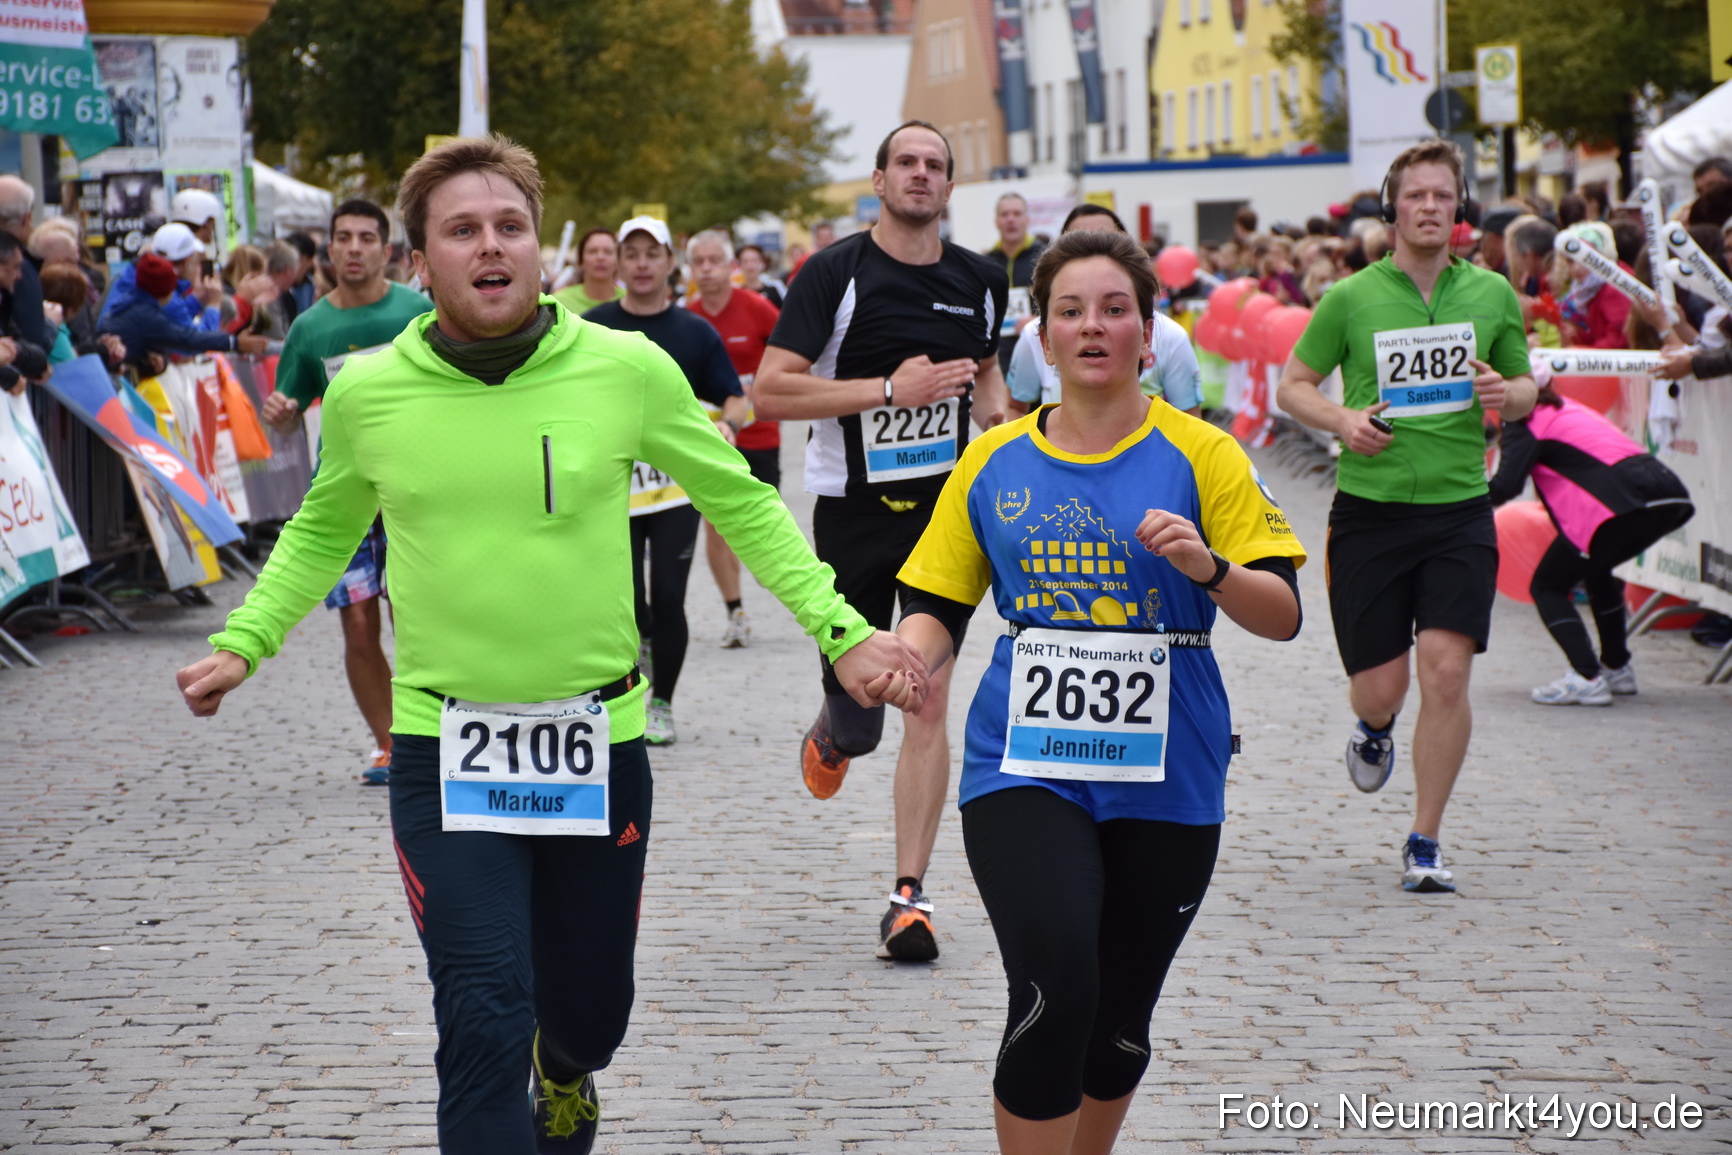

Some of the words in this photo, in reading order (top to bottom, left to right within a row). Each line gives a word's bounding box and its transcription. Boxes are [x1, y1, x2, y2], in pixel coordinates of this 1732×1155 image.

[1378, 339, 1411, 348] PARTL
[1413, 334, 1459, 345] Neumarkt
[1388, 346, 1468, 384] 2482
[1577, 358, 1612, 372] BMW
[1407, 388, 1451, 404] Sascha
[873, 403, 950, 445] 2222
[896, 449, 937, 466] Martin
[1039, 580, 1098, 591] September
[1101, 581, 1128, 591] 2014
[1017, 643, 1065, 658] PARTL
[1069, 646, 1144, 663] Neumarkt
[1024, 665, 1155, 724] 2632
[460, 721, 593, 776] 2106
[1040, 735, 1127, 760] Jennifer
[488, 789, 564, 813] Markus
[617, 834, 640, 847] adidas
